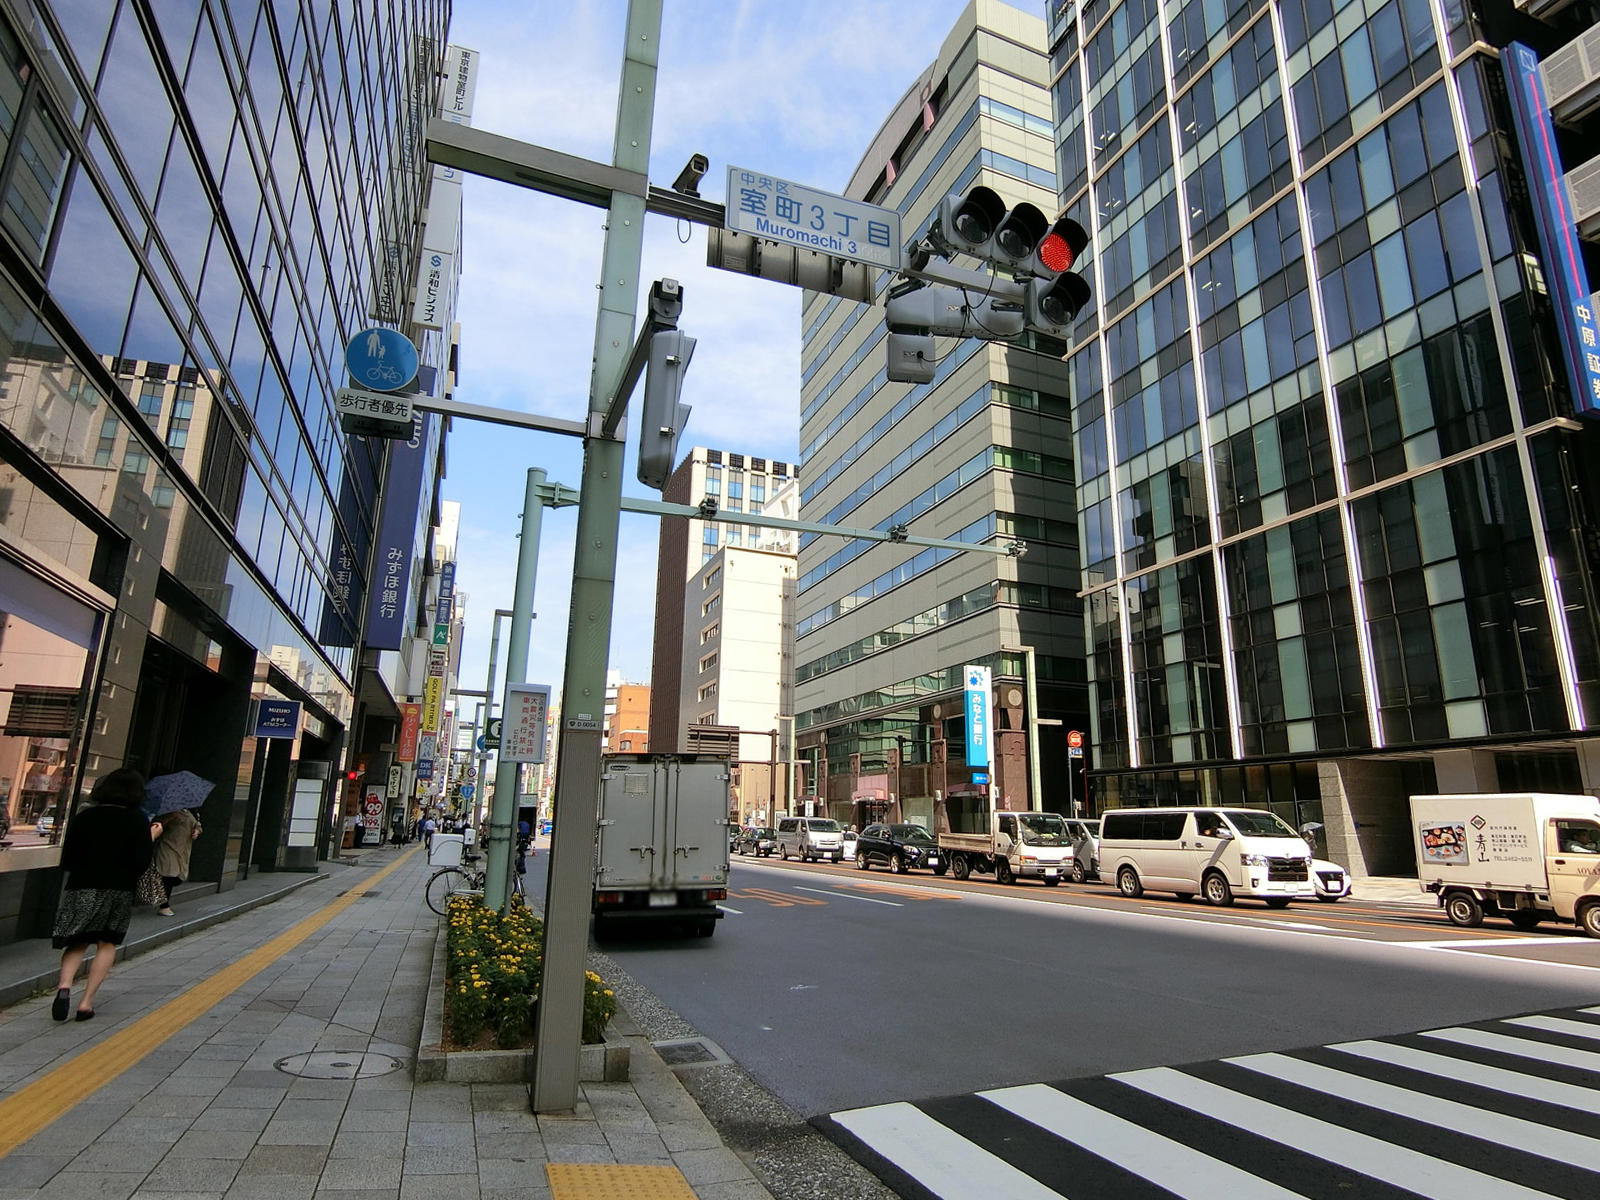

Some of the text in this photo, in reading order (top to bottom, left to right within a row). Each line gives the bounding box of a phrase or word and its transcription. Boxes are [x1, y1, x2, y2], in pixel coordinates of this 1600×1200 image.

[454, 50, 471, 111] 東京建物室町ビル
[740, 172, 790, 196] 中央区
[739, 187, 890, 248] 室町3丁目
[756, 217, 857, 254] Muromachi 3
[340, 394, 409, 418] 歩行者優先
[380, 547, 404, 619] みずほ銀行
[402, 715, 416, 757] ふくしま館
[518, 696, 530, 755] 車両通行禁止
[526, 697, 538, 755] 大震災等発生時
[972, 693, 983, 746] みなと銀行
[1475, 833, 1490, 863] 青山
